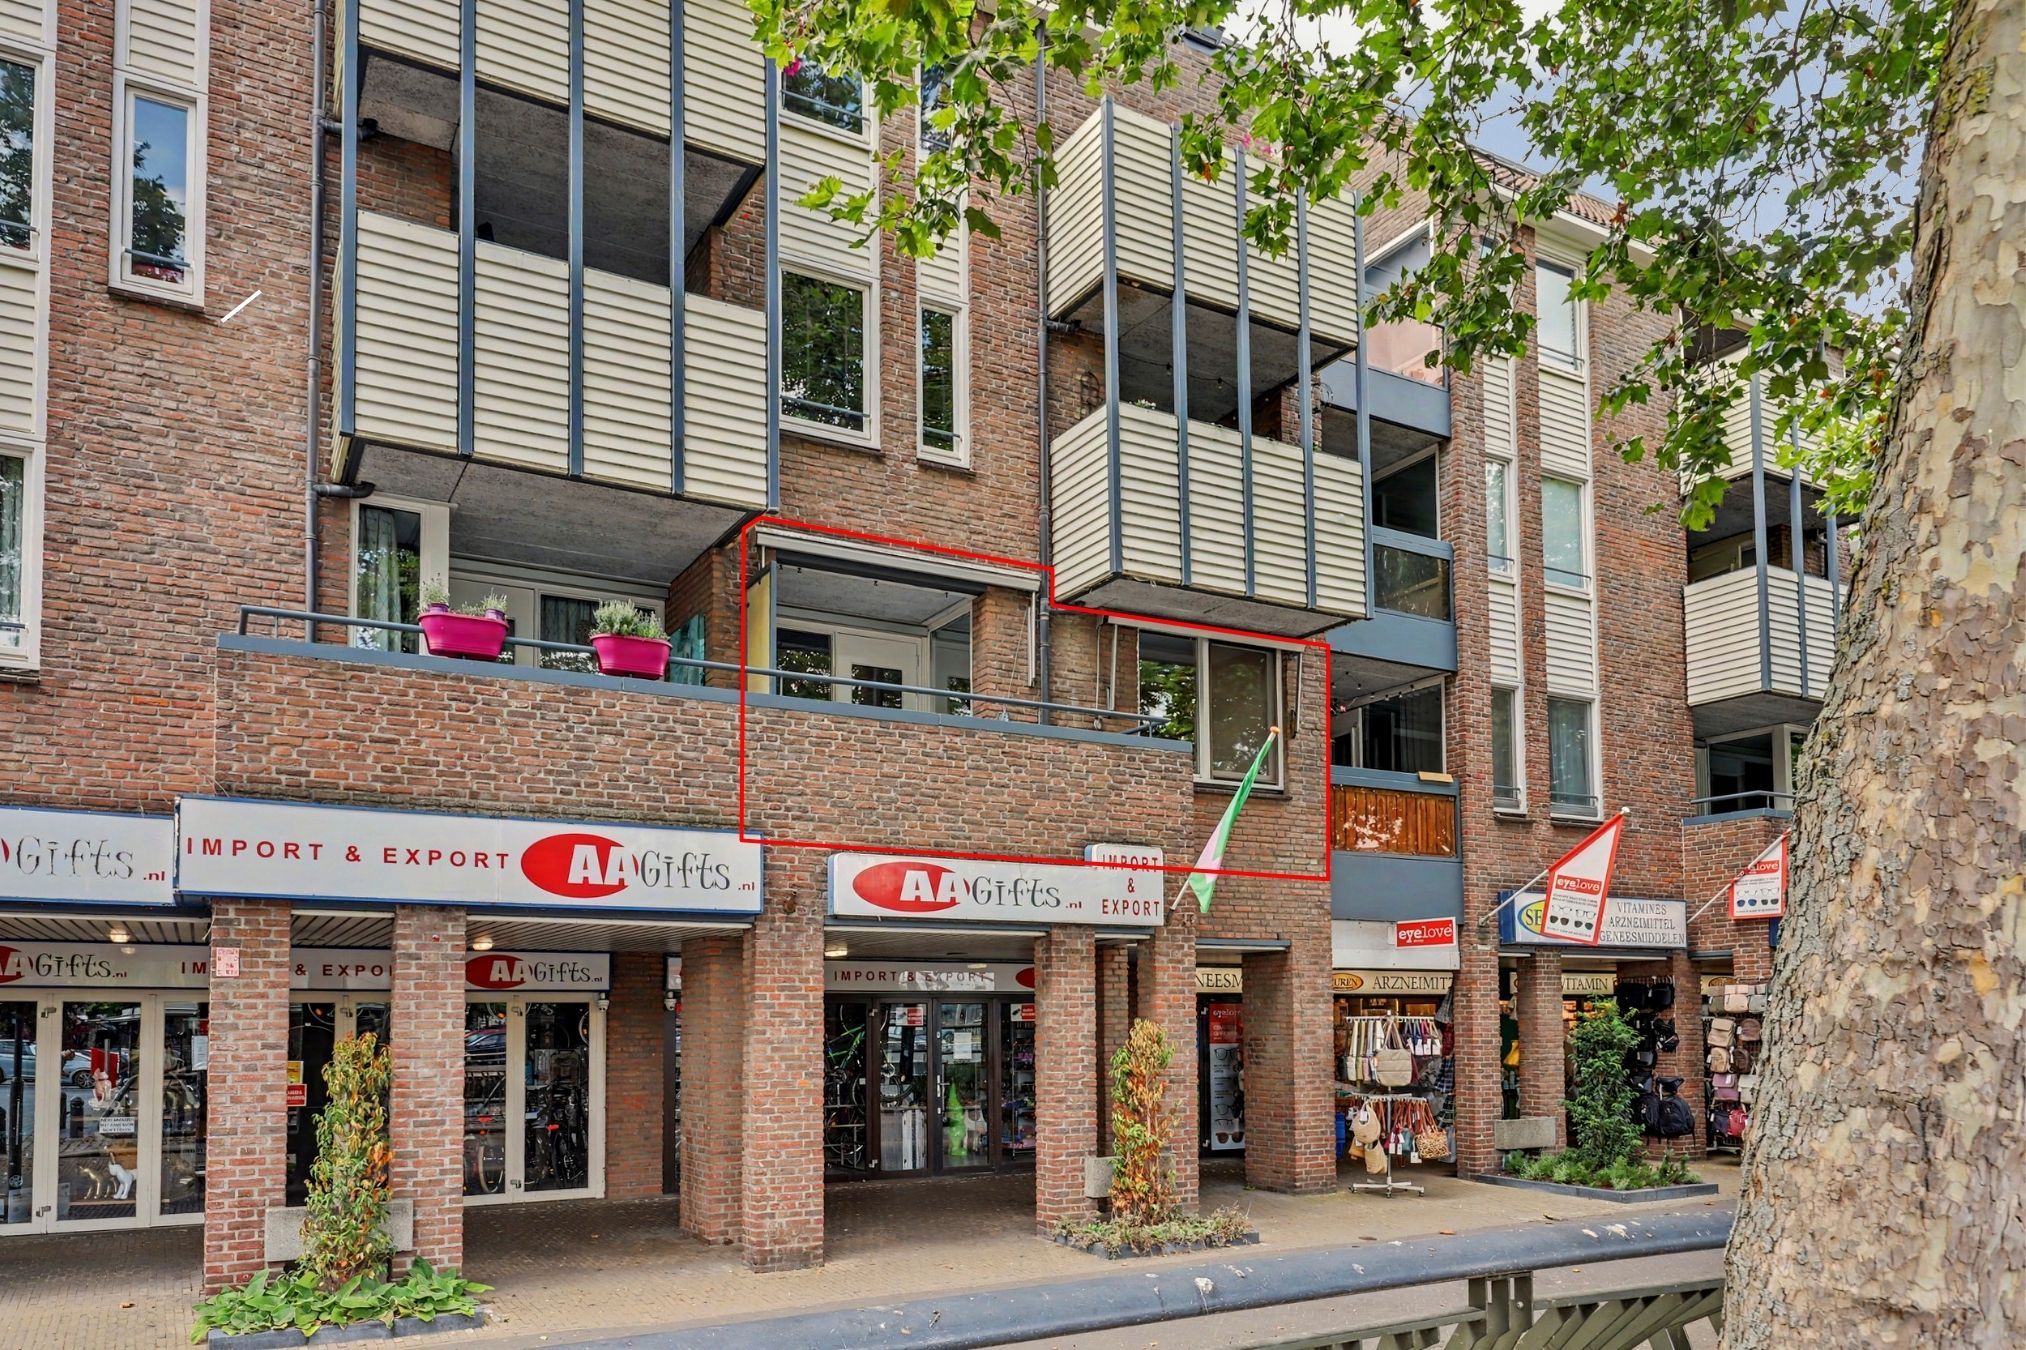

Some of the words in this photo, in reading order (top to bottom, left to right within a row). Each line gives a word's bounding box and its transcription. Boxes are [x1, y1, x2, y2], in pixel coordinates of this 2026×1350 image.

[186, 837, 324, 860] IMPORT
[345, 845, 362, 863] &
[383, 847, 510, 869] EXPORT
[1127, 877, 1136, 893] &
[1557, 878, 1600, 892] eyelove
[1102, 898, 1160, 917] EXPORT
[1616, 901, 1667, 915] VITAMINES
[1608, 916, 1676, 930] ARZNEIMITTEL
[1398, 925, 1453, 944] eyelove
[1599, 930, 1686, 945] GENEESMIDDELEN
[295, 963, 307, 976] &
[322, 964, 393, 977] EXPO
[834, 970, 897, 982] IMPORT
[906, 970, 916, 982] &
[925, 971, 986, 983] EXPORT
